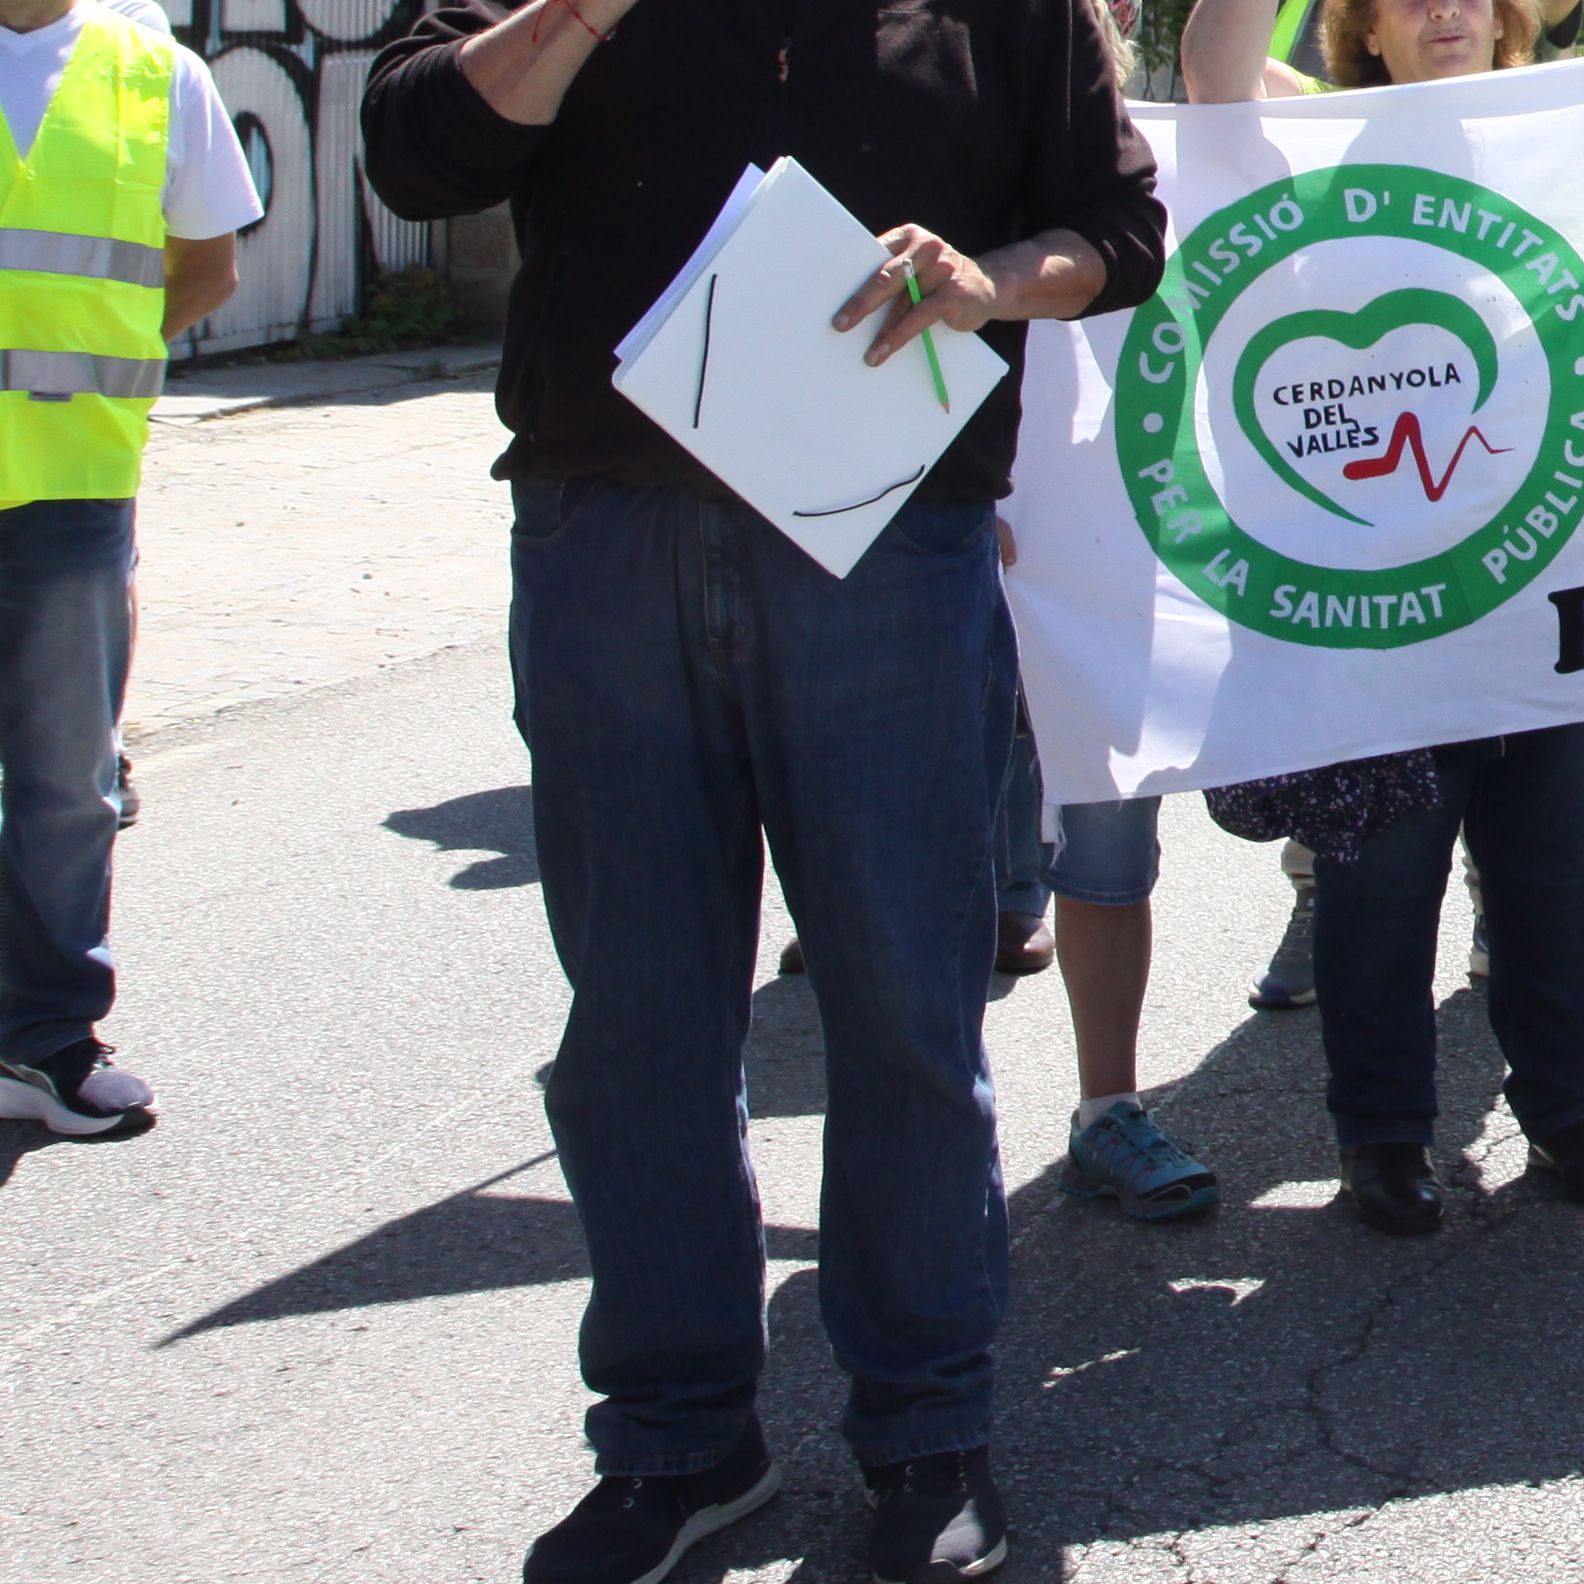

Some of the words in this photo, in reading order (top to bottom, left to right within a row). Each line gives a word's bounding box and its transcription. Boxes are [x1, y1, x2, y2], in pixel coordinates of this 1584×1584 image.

[1138, 192, 1304, 384] COMISSIÓ
[1272, 363, 1462, 405] CERDANYOLA
[1303, 403, 1357, 430] DEL
[1138, 457, 1203, 544] PER
[1202, 547, 1251, 597] LA
[1270, 583, 1447, 629] SANITAT
